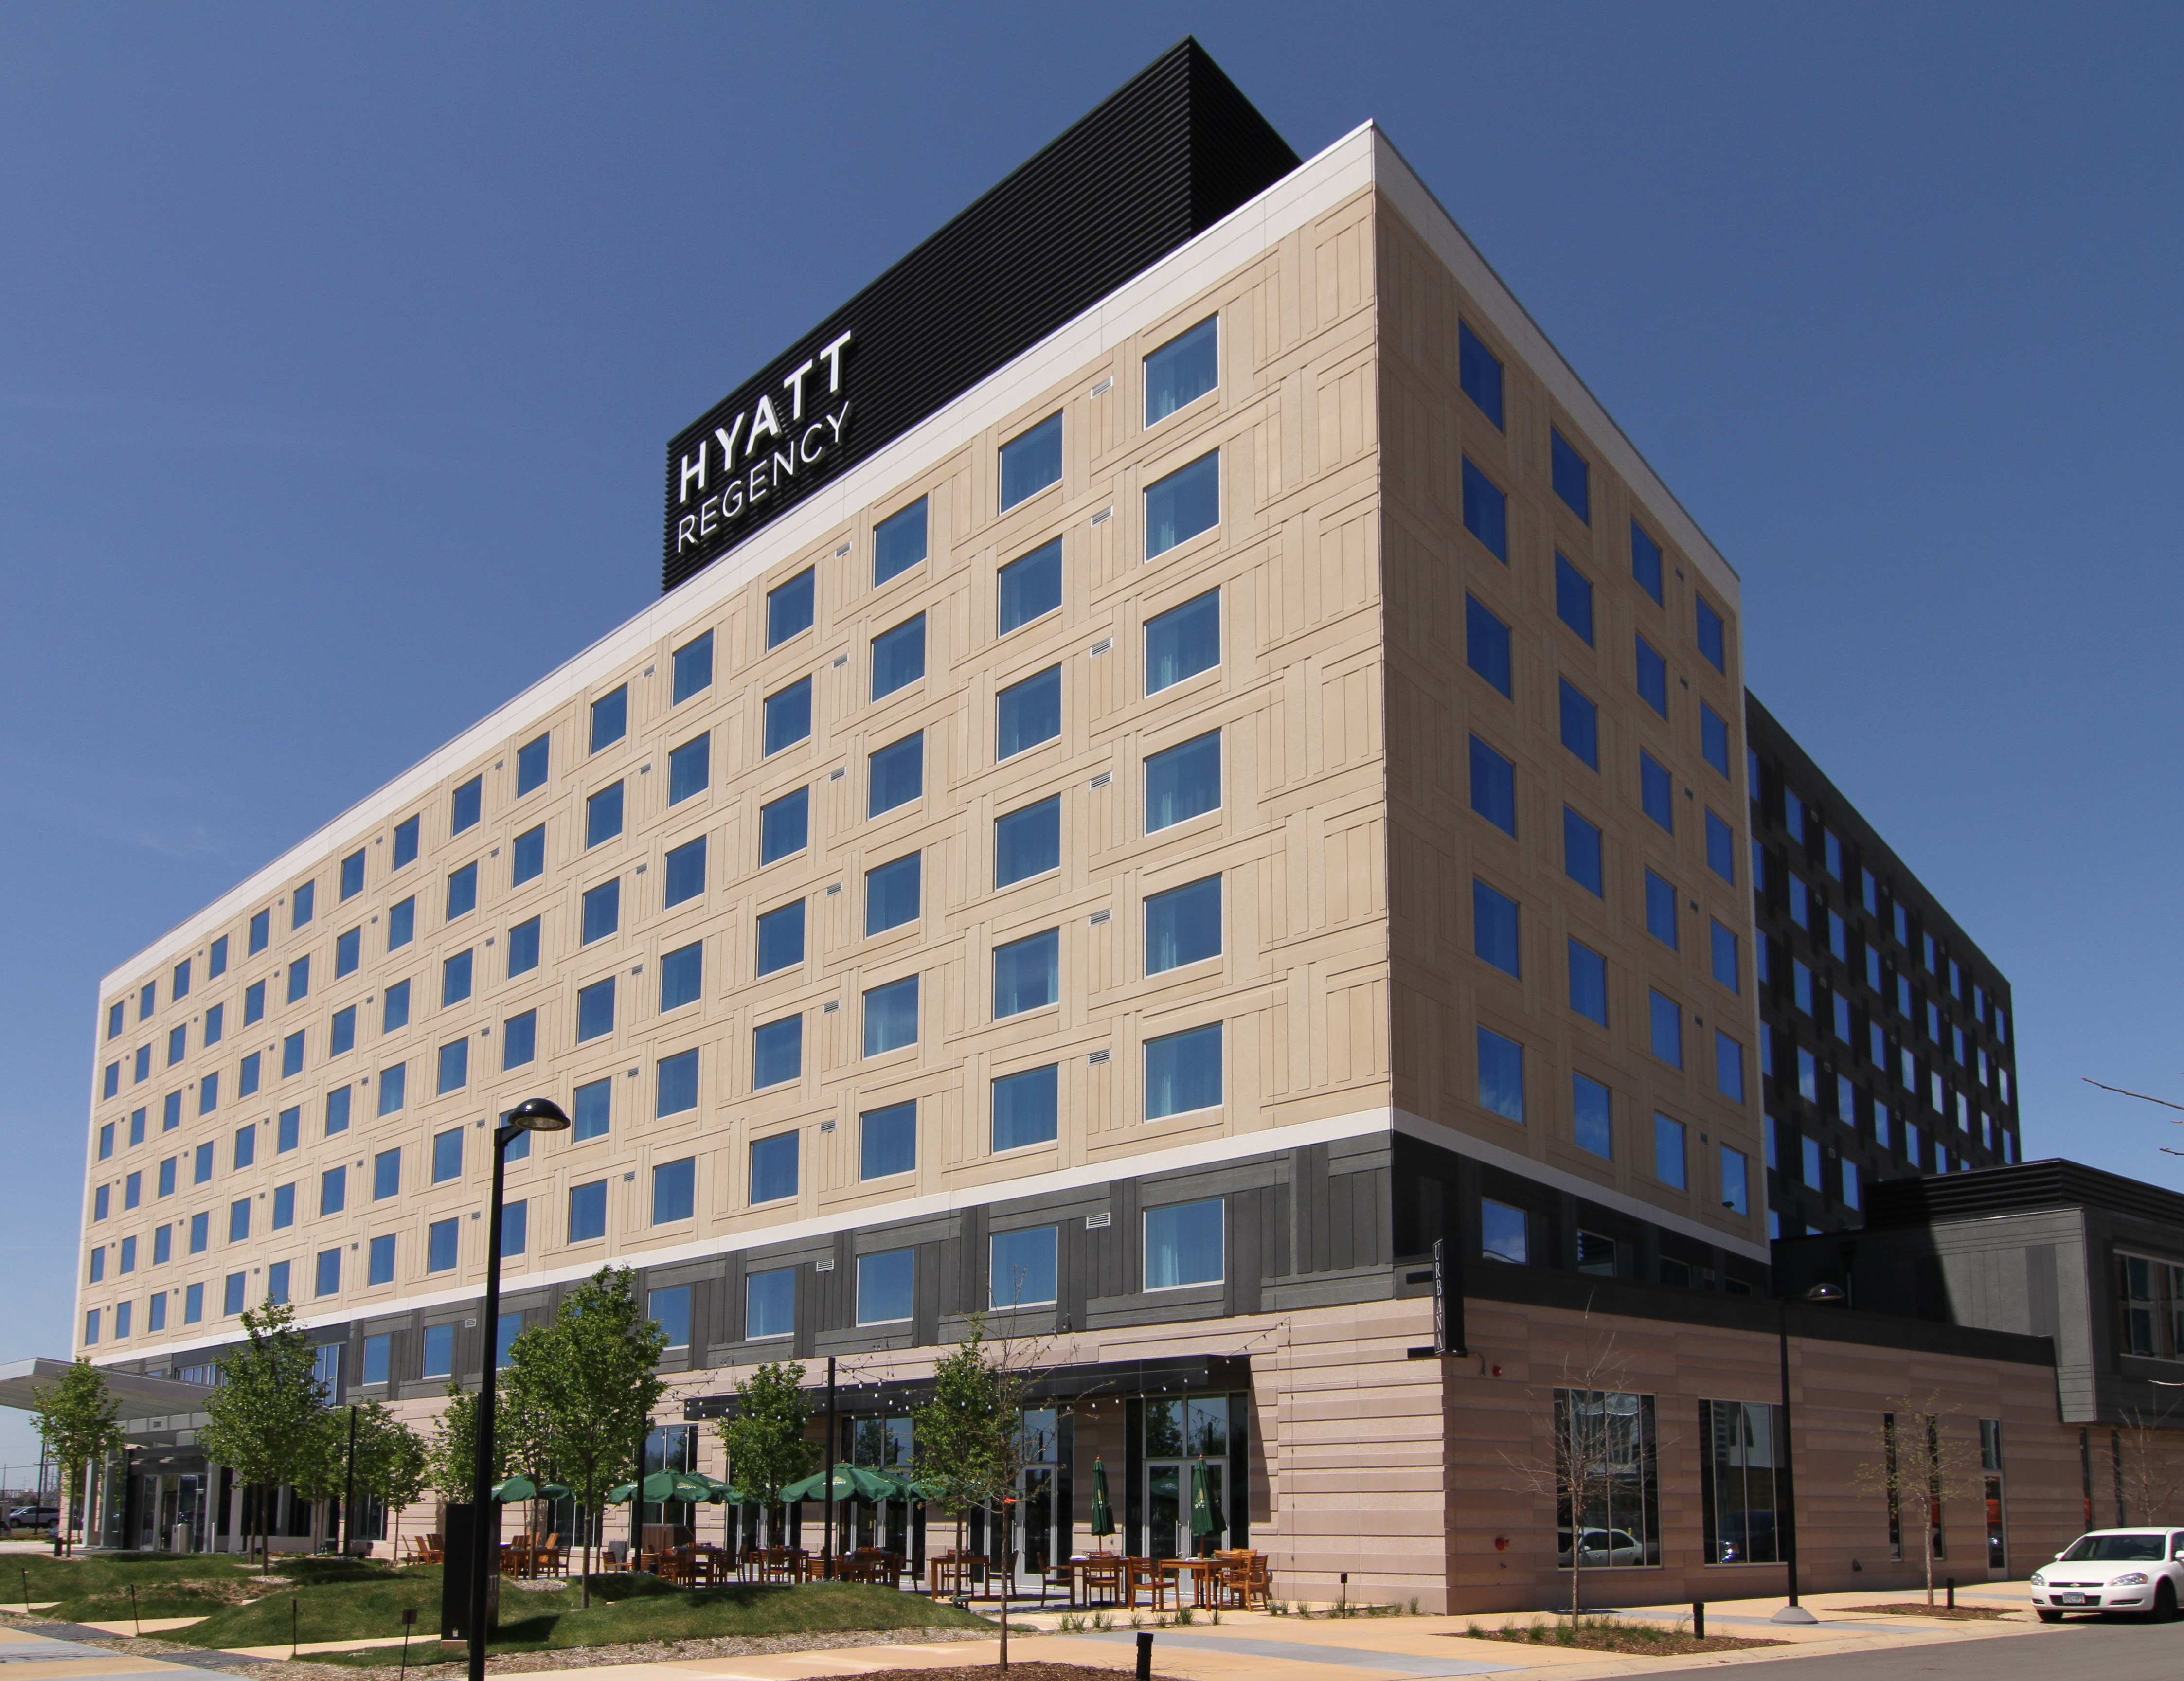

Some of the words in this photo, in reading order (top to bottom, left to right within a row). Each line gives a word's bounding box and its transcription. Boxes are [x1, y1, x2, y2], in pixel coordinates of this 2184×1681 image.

[678, 401, 850, 553] REGENCY
[680, 330, 851, 504] HYATT
[1434, 1243, 1443, 1350] URBANA
